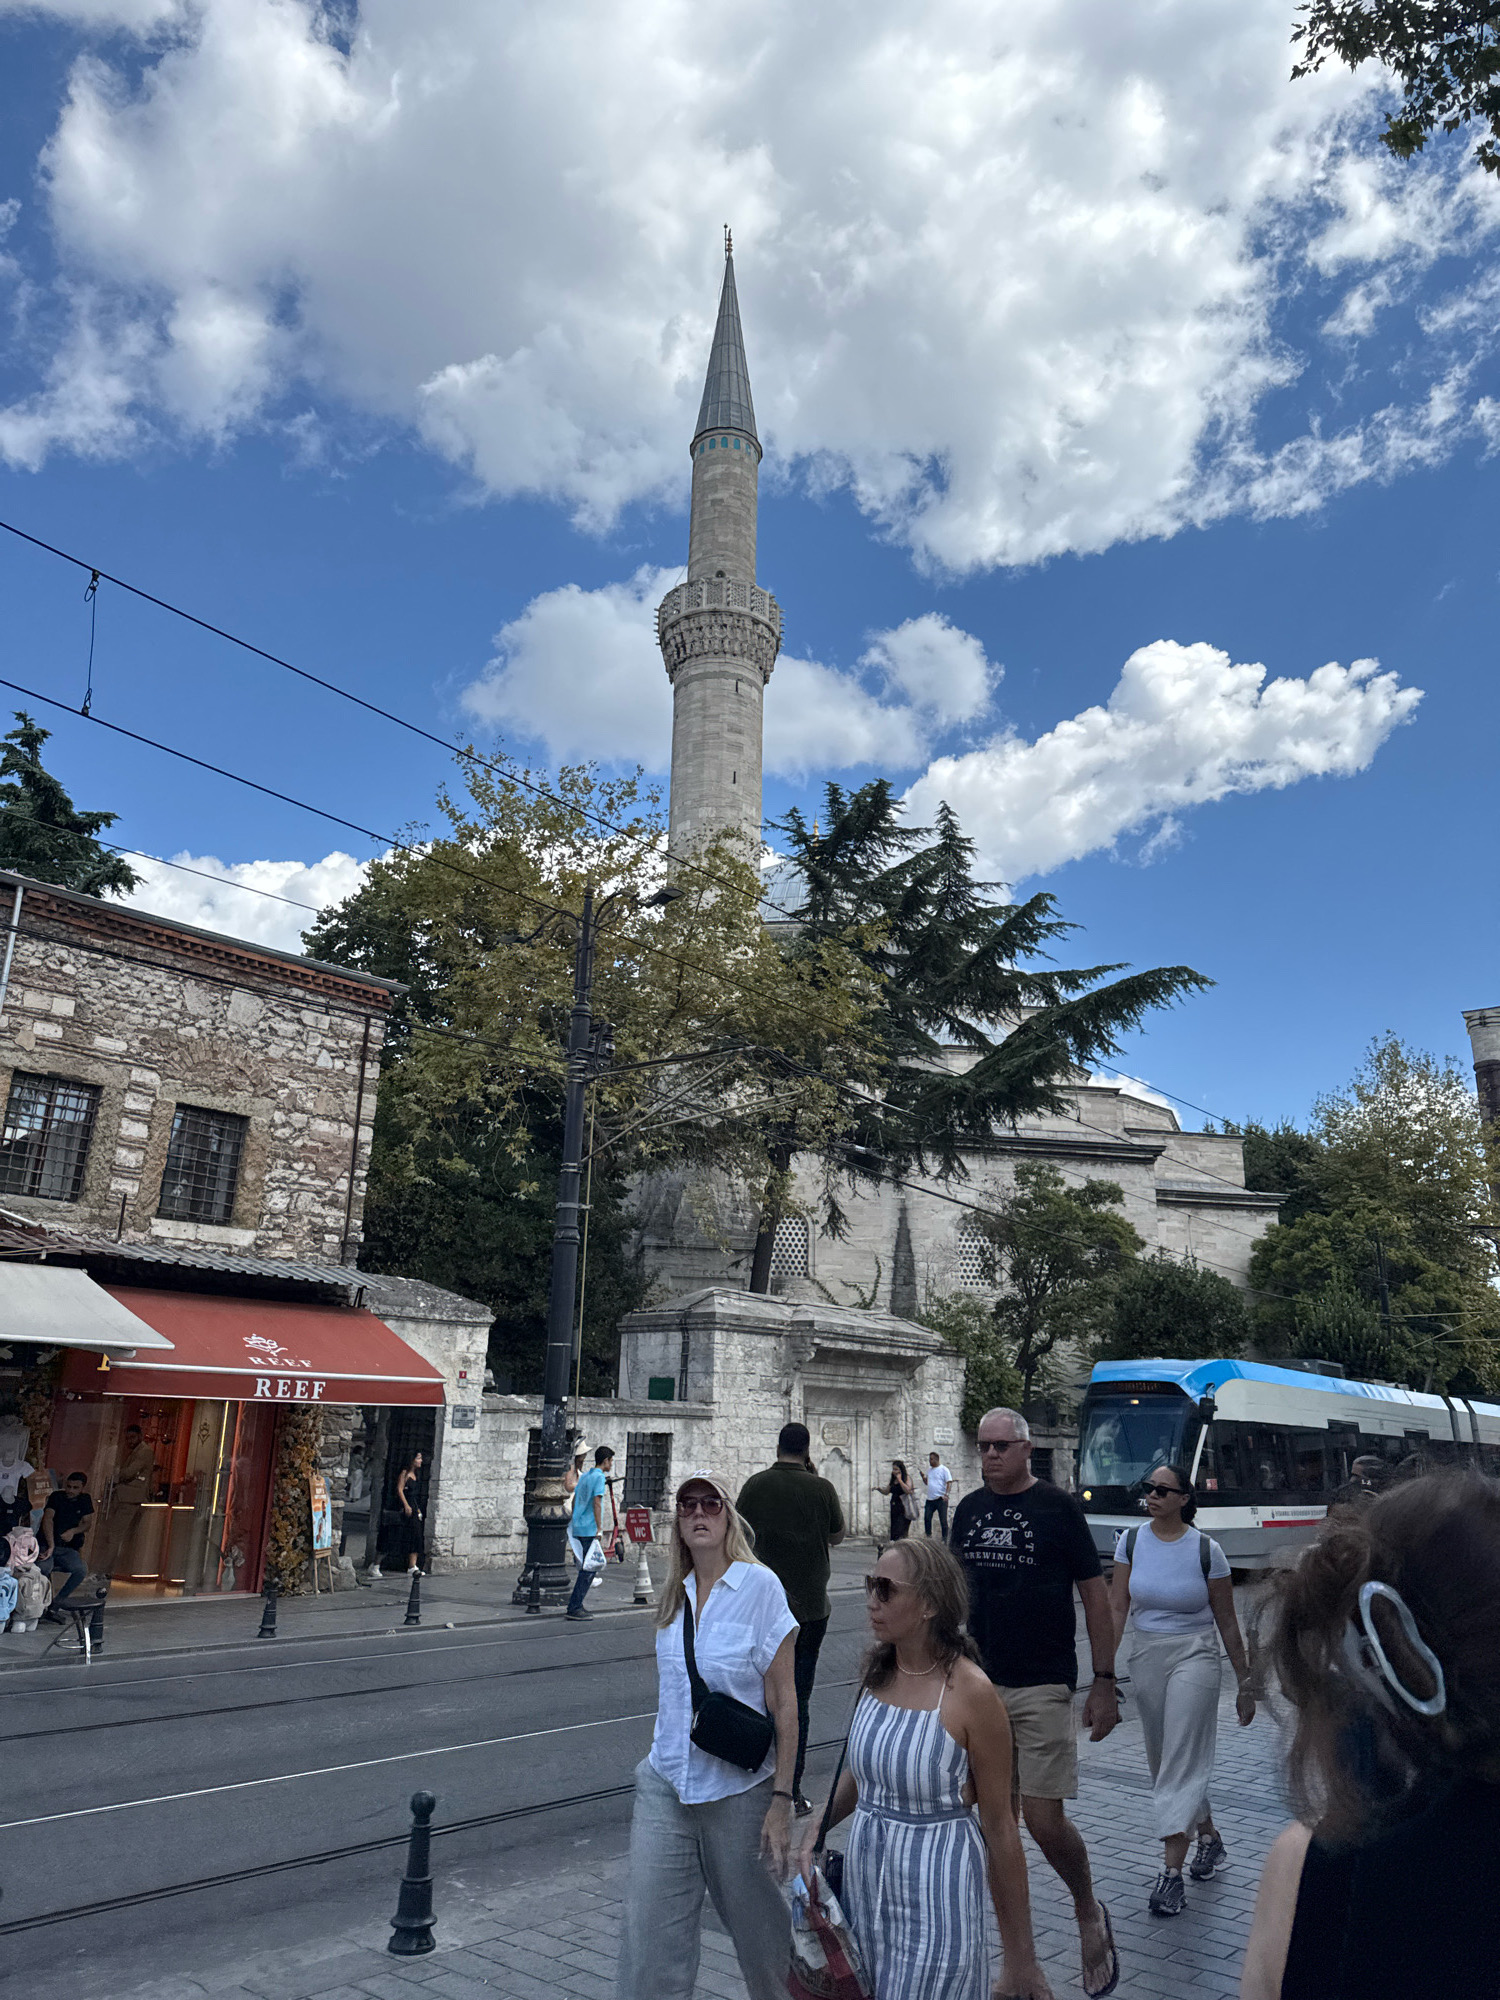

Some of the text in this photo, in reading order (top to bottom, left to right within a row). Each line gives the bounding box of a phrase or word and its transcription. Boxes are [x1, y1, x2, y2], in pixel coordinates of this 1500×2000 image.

[247, 1357, 313, 1368] REEF
[253, 1377, 327, 1400] REEF
[634, 1526, 646, 1538] WC
[963, 1508, 1034, 1552] LEFT COAST
